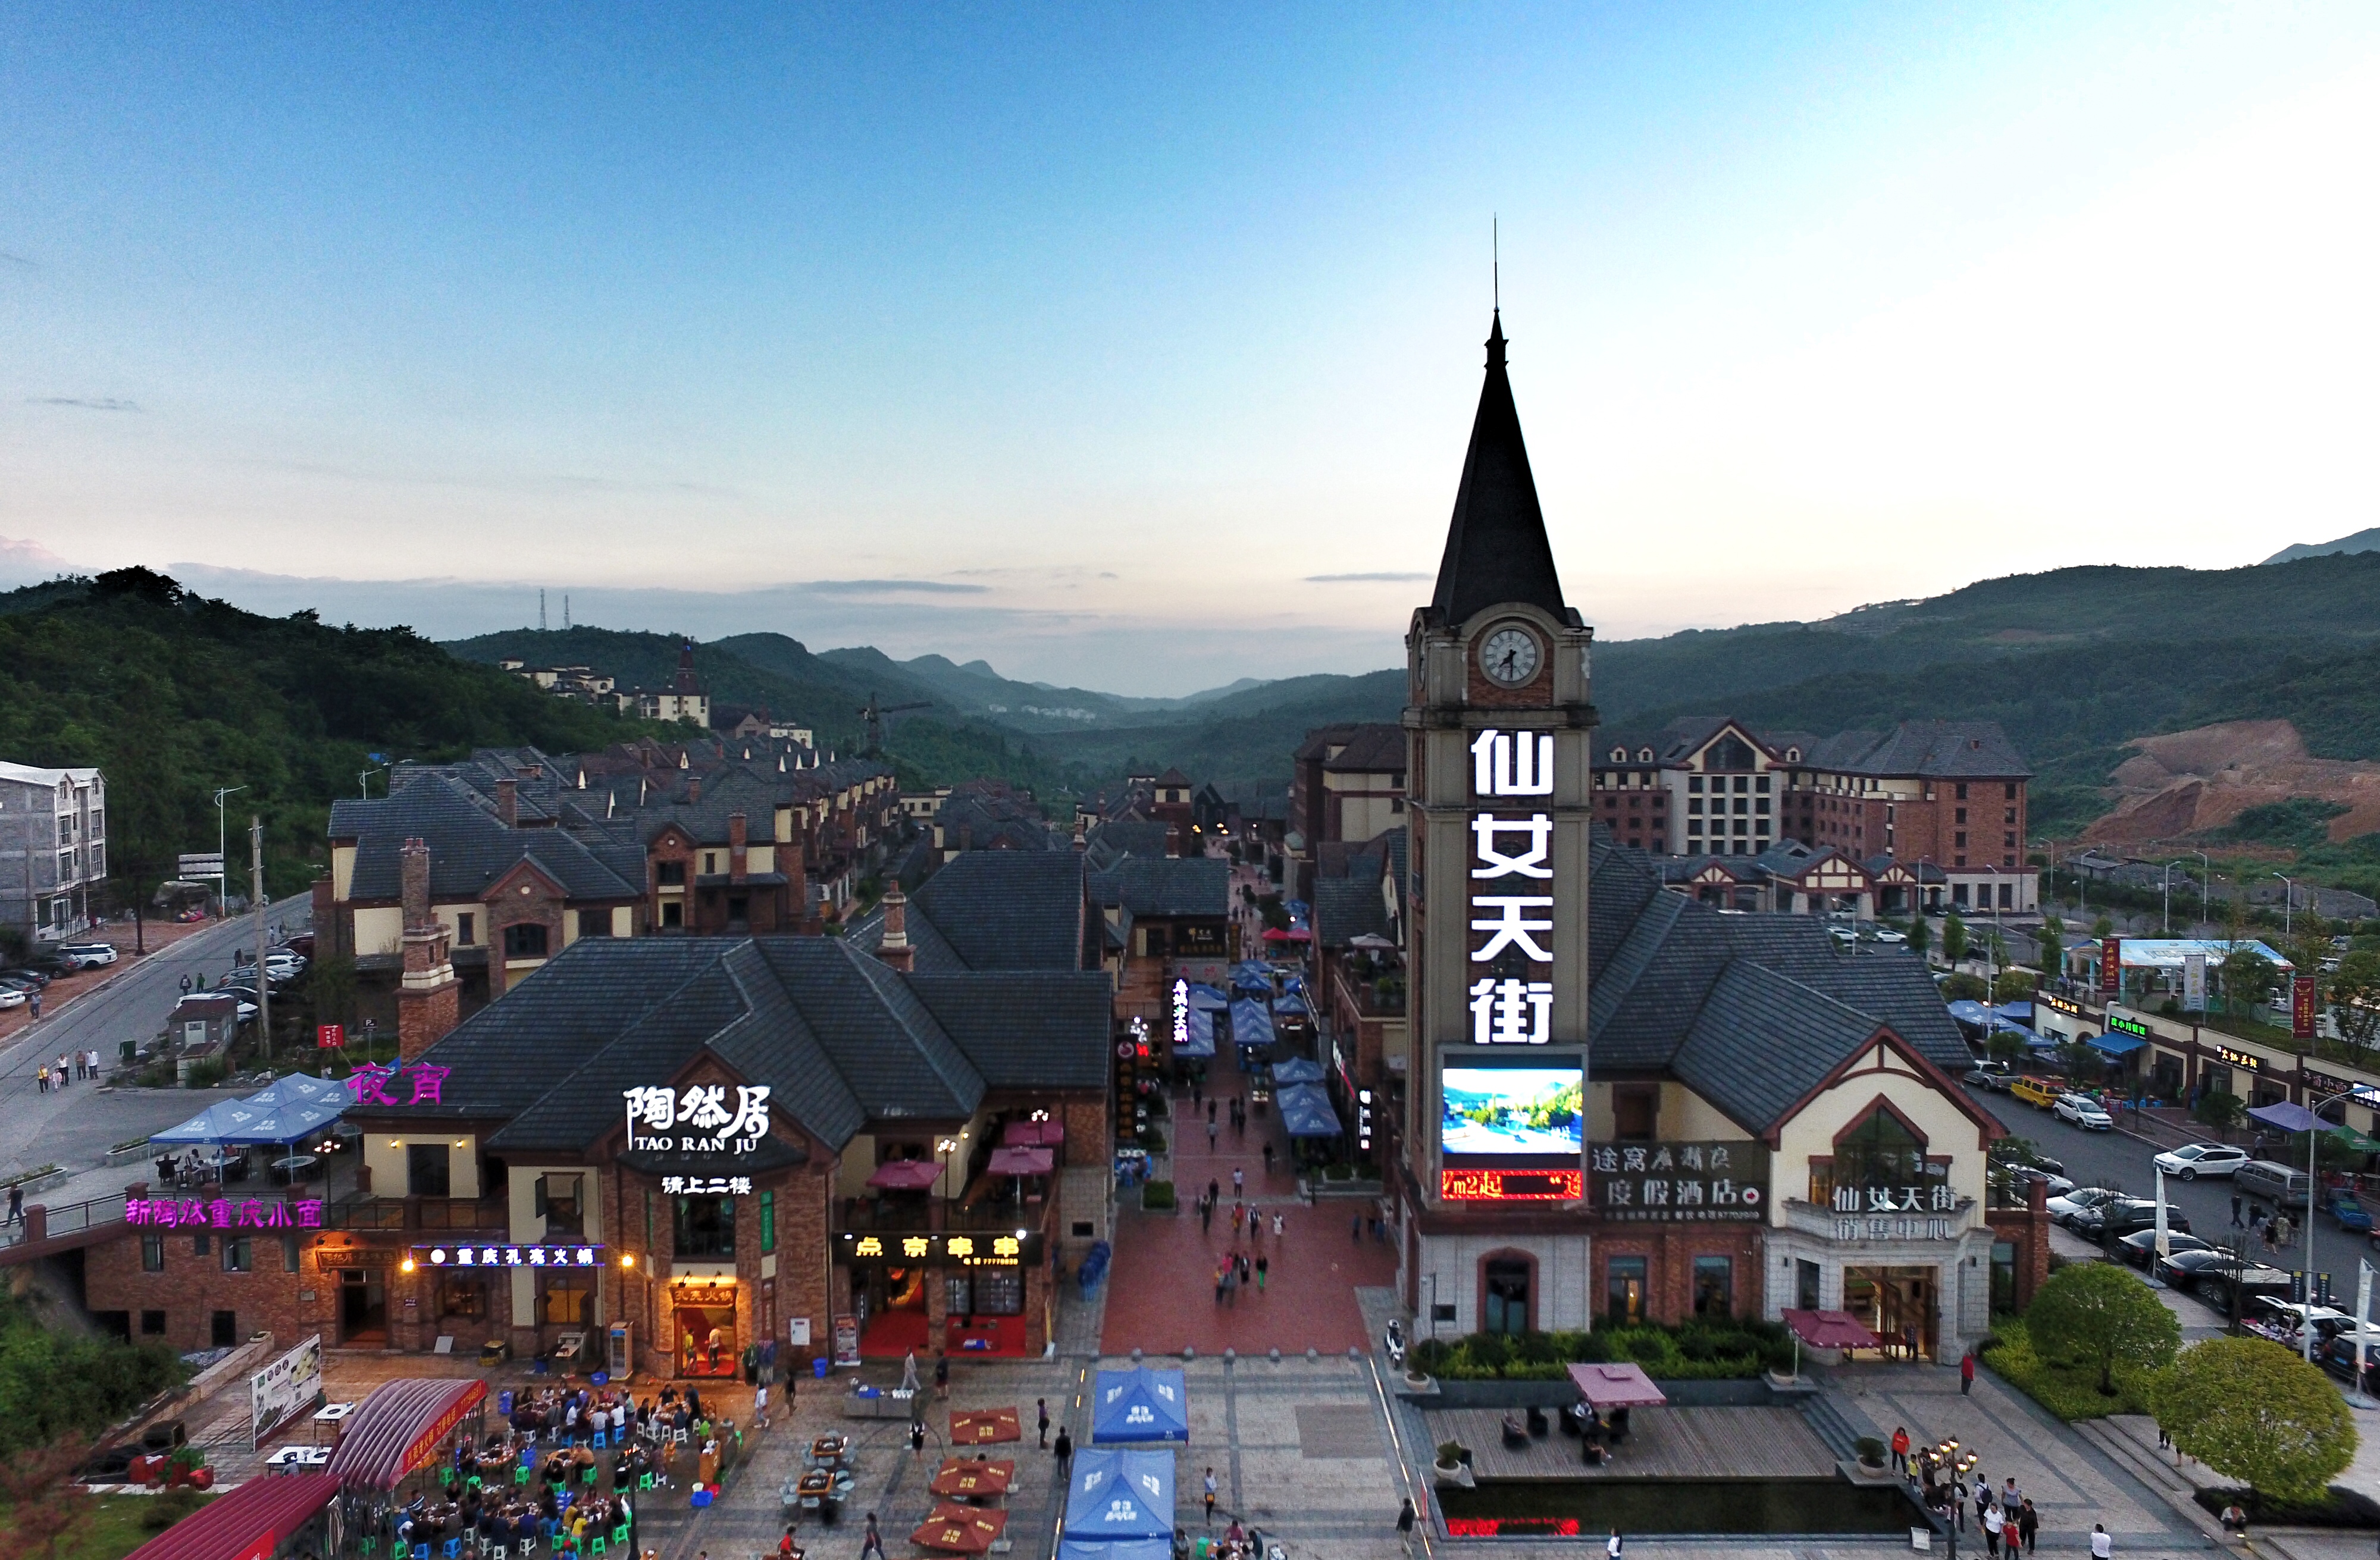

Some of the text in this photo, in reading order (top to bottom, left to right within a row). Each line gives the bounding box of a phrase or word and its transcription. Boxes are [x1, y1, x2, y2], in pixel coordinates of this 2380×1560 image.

[1470, 729, 1554, 1044] 仙女天街
[347, 1061, 451, 1105] 夜宵
[623, 1085, 771, 1151] 陶然居
[634, 1137, 757, 1155] TAO RAN JU
[661, 1176, 752, 1195] 请上二楼
[1608, 1178, 1737, 1205] 度假酒店
[1834, 1185, 1958, 1211] 仙女天街
[1837, 1218, 1950, 1241] 销售中心
[457, 1248, 594, 1265] 重庆孔亮火锅
[674, 1290, 733, 1302] 孔亮火锅
